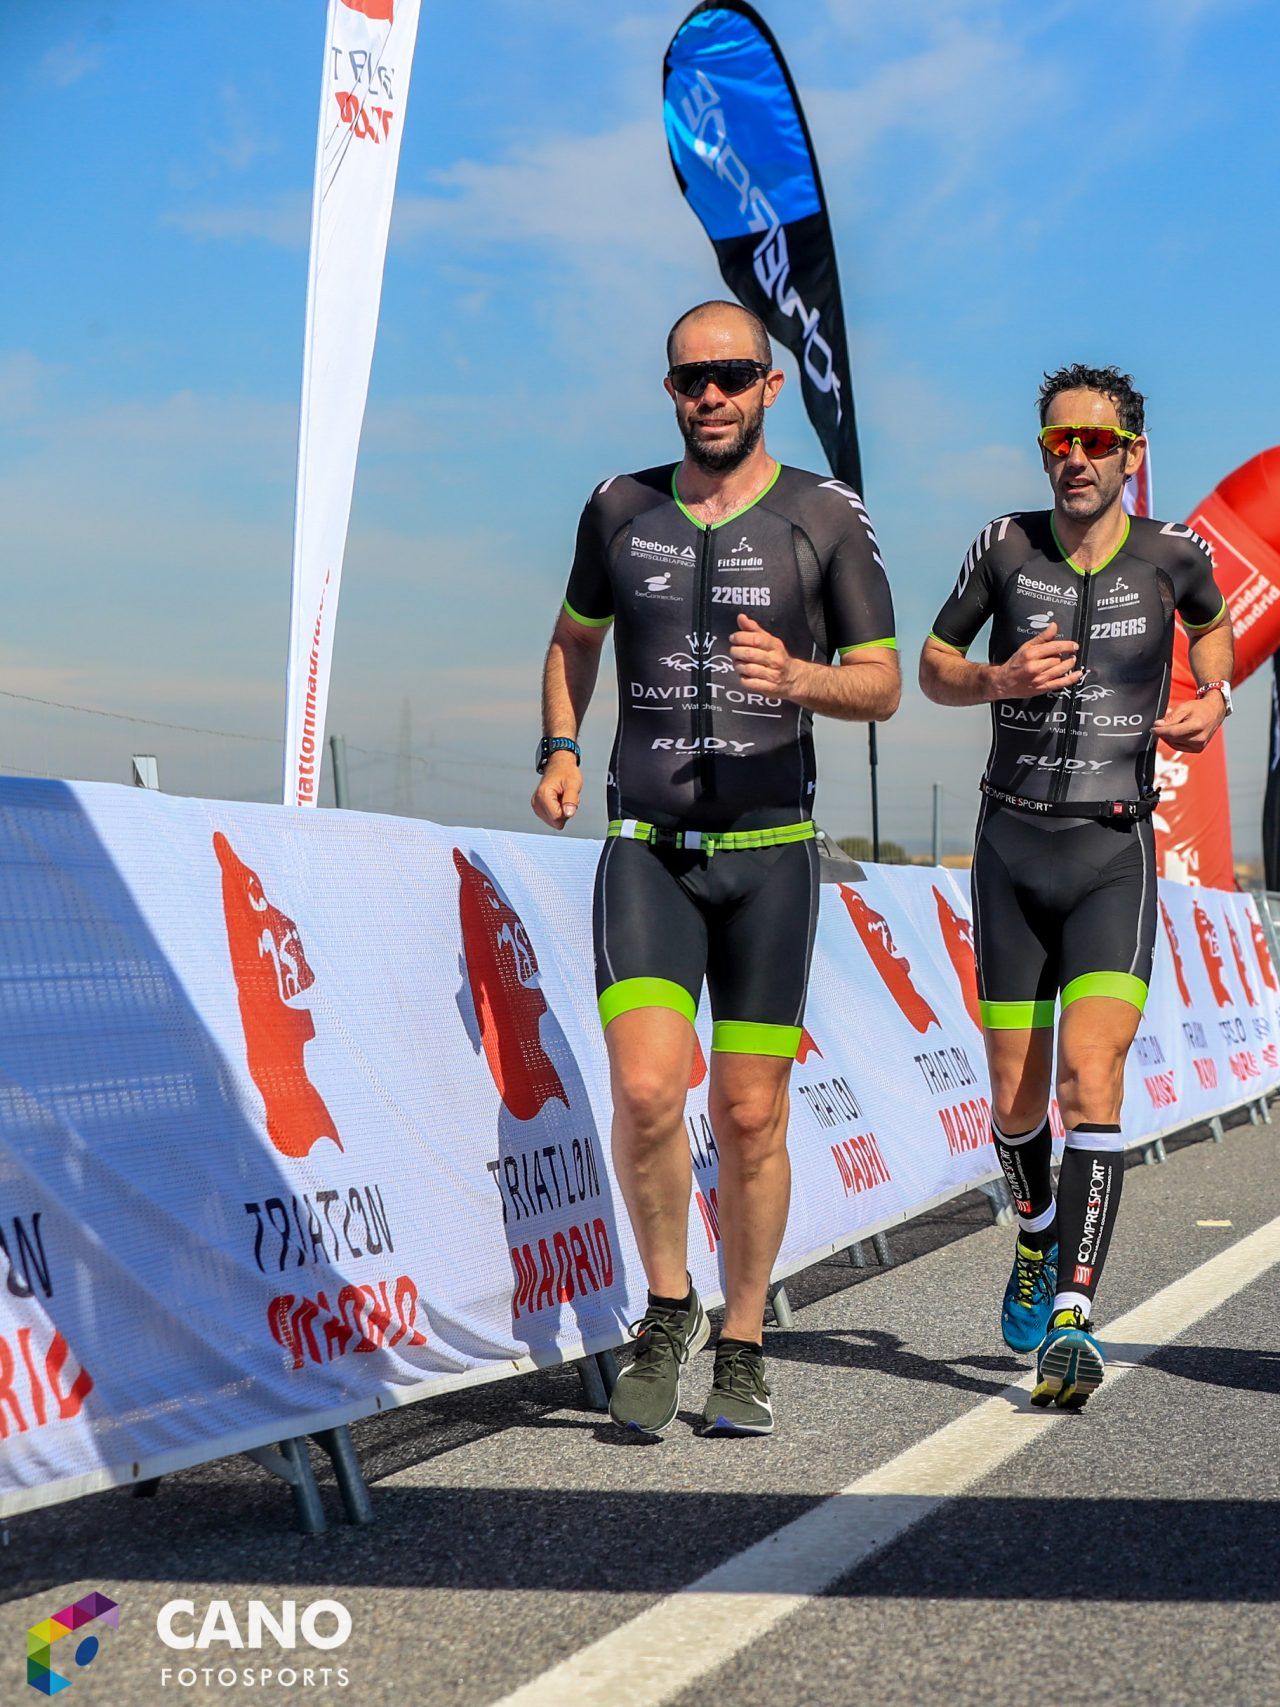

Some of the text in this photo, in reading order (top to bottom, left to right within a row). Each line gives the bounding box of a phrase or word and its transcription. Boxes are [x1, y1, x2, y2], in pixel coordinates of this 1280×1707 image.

[631, 537, 679, 556] Reebok
[718, 557, 763, 568] FitStudio
[1017, 574, 1062, 595] Reebok
[711, 586, 772, 606] 226ERS
[1097, 592, 1139, 607] FitStudio
[1090, 617, 1146, 640] 226ERS
[631, 682, 698, 699] DAVID
[1000, 704, 1143, 726] DAVID TORO
[651, 737, 756, 752] RUDY
[1016, 754, 1112, 771] RUDY
[486, 1136, 600, 1223] TRIATLON
[511, 1218, 613, 1319] MADRID
